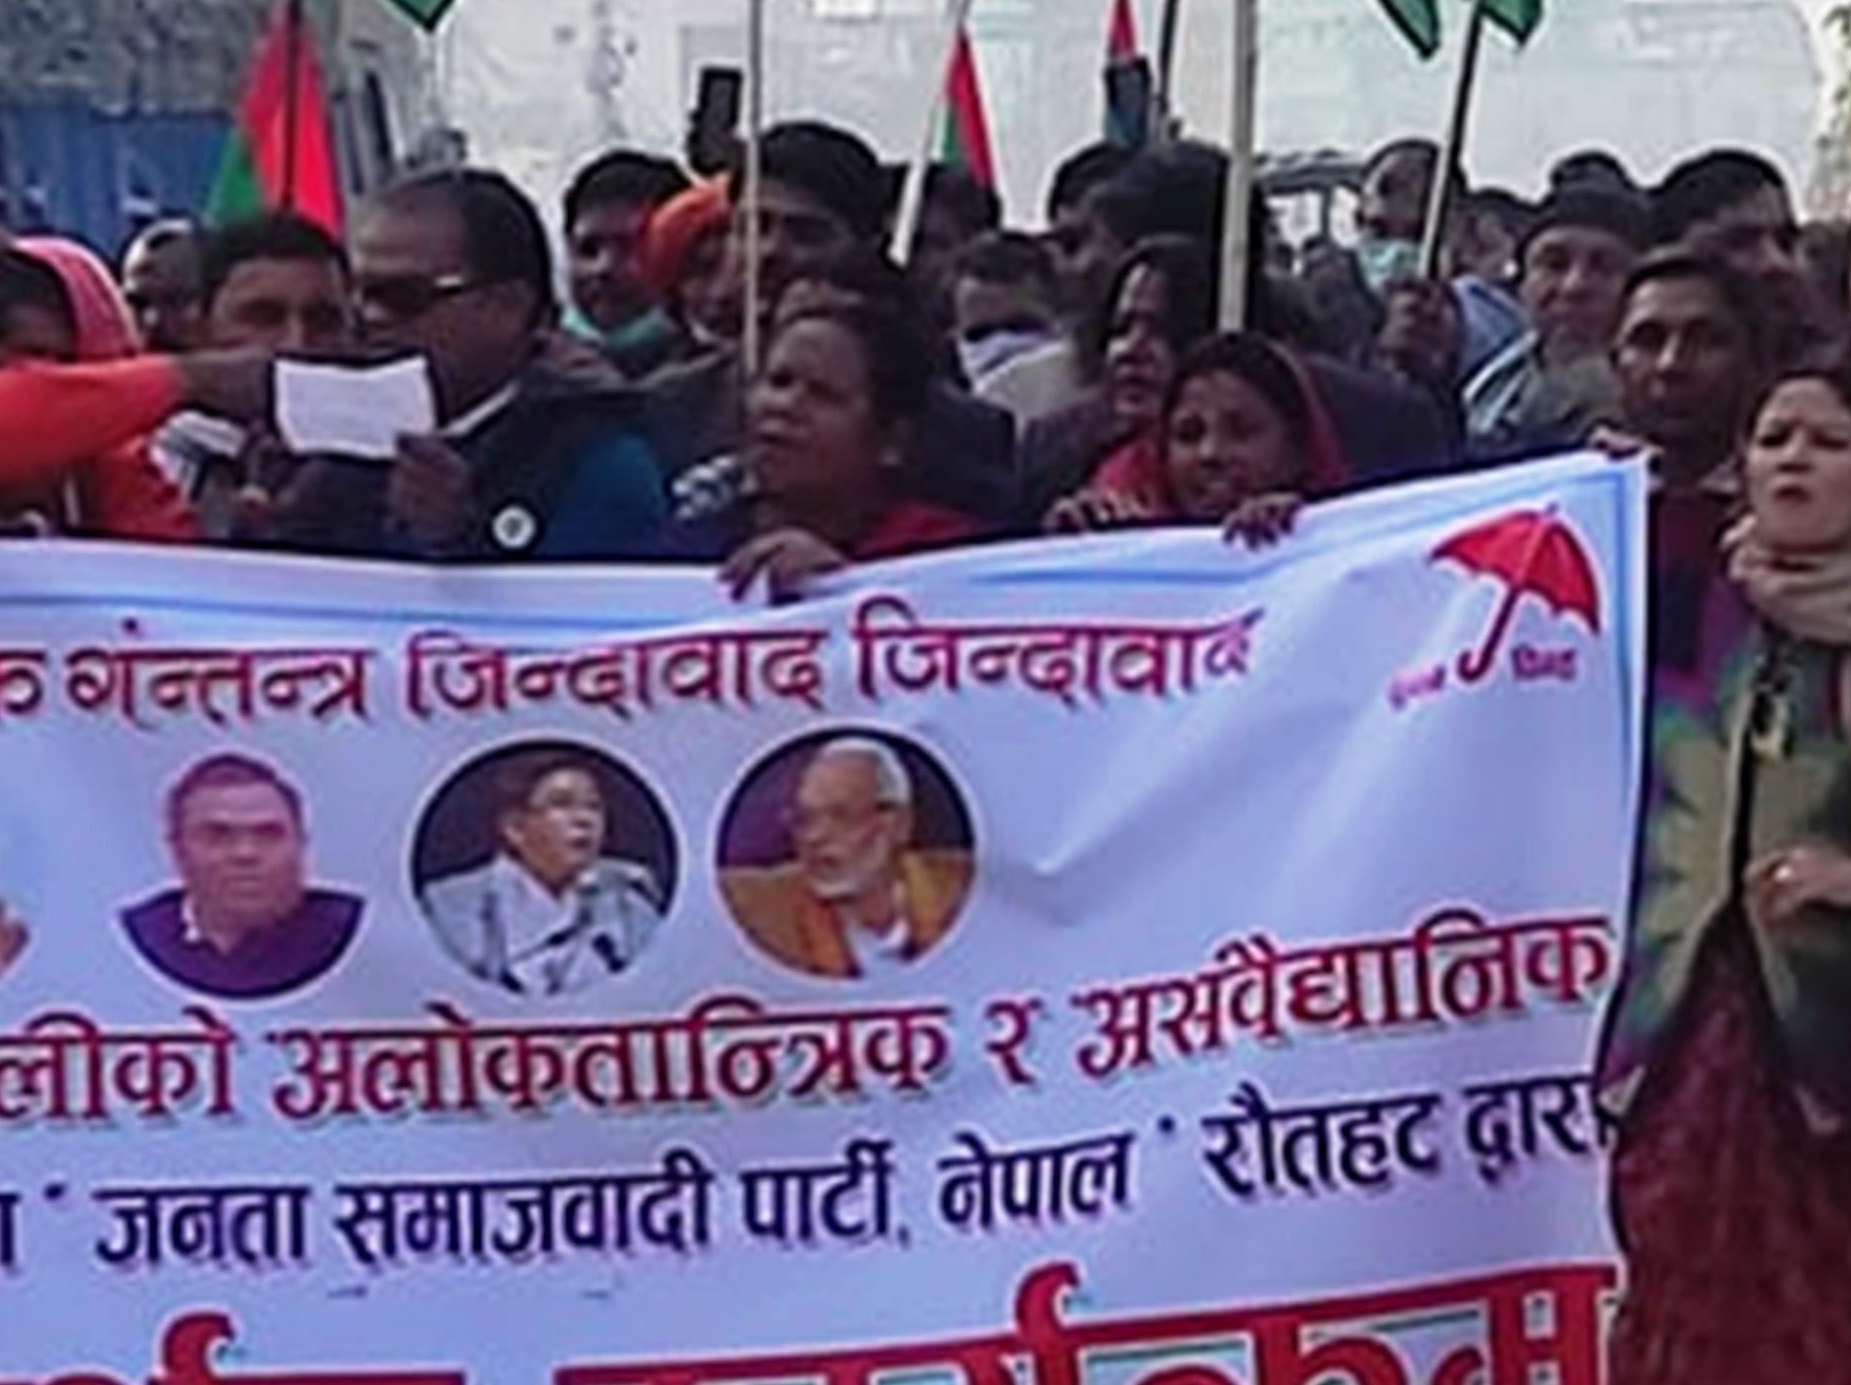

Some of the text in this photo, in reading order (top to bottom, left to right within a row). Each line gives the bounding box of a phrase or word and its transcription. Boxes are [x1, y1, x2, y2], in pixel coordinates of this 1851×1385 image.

[986, 1000, 1041, 1086] र
[93, 1185, 310, 1269] जनता
[336, 1150, 713, 1269] समाजवादी
[939, 1131, 1134, 1229] नेपाल
[1201, 1081, 1442, 1199] रौतहट
